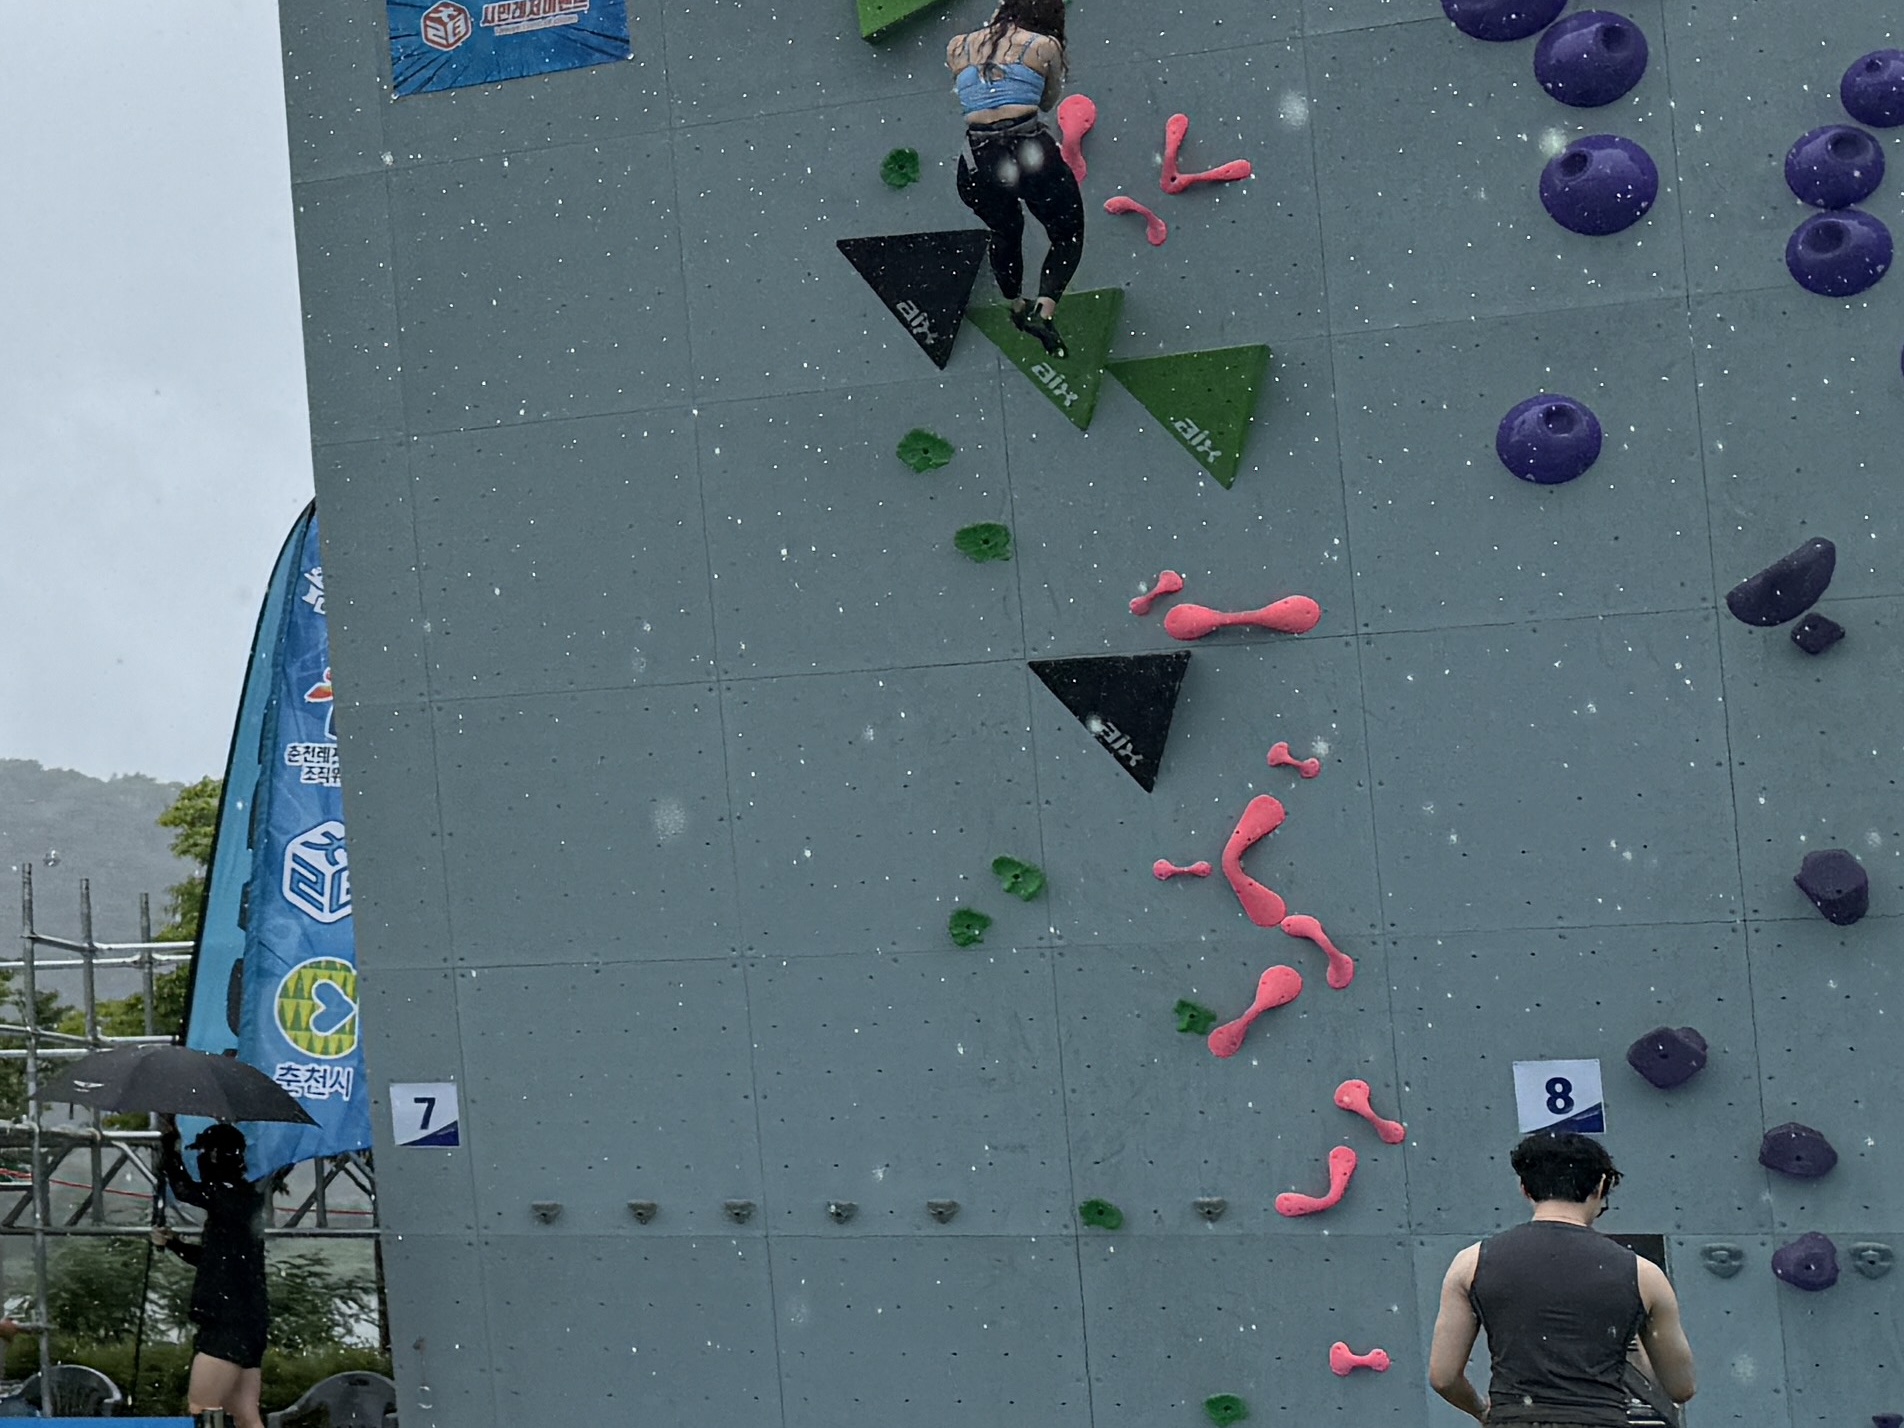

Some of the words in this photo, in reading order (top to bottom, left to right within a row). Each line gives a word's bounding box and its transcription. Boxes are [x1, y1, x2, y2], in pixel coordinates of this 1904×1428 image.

[896, 300, 939, 345] aix
[1031, 362, 1078, 407] aix
[1174, 418, 1222, 463] aix
[275, 1063, 353, 1100] 춘천시
[1545, 1077, 1574, 1114] 8
[414, 1097, 436, 1130] 7
